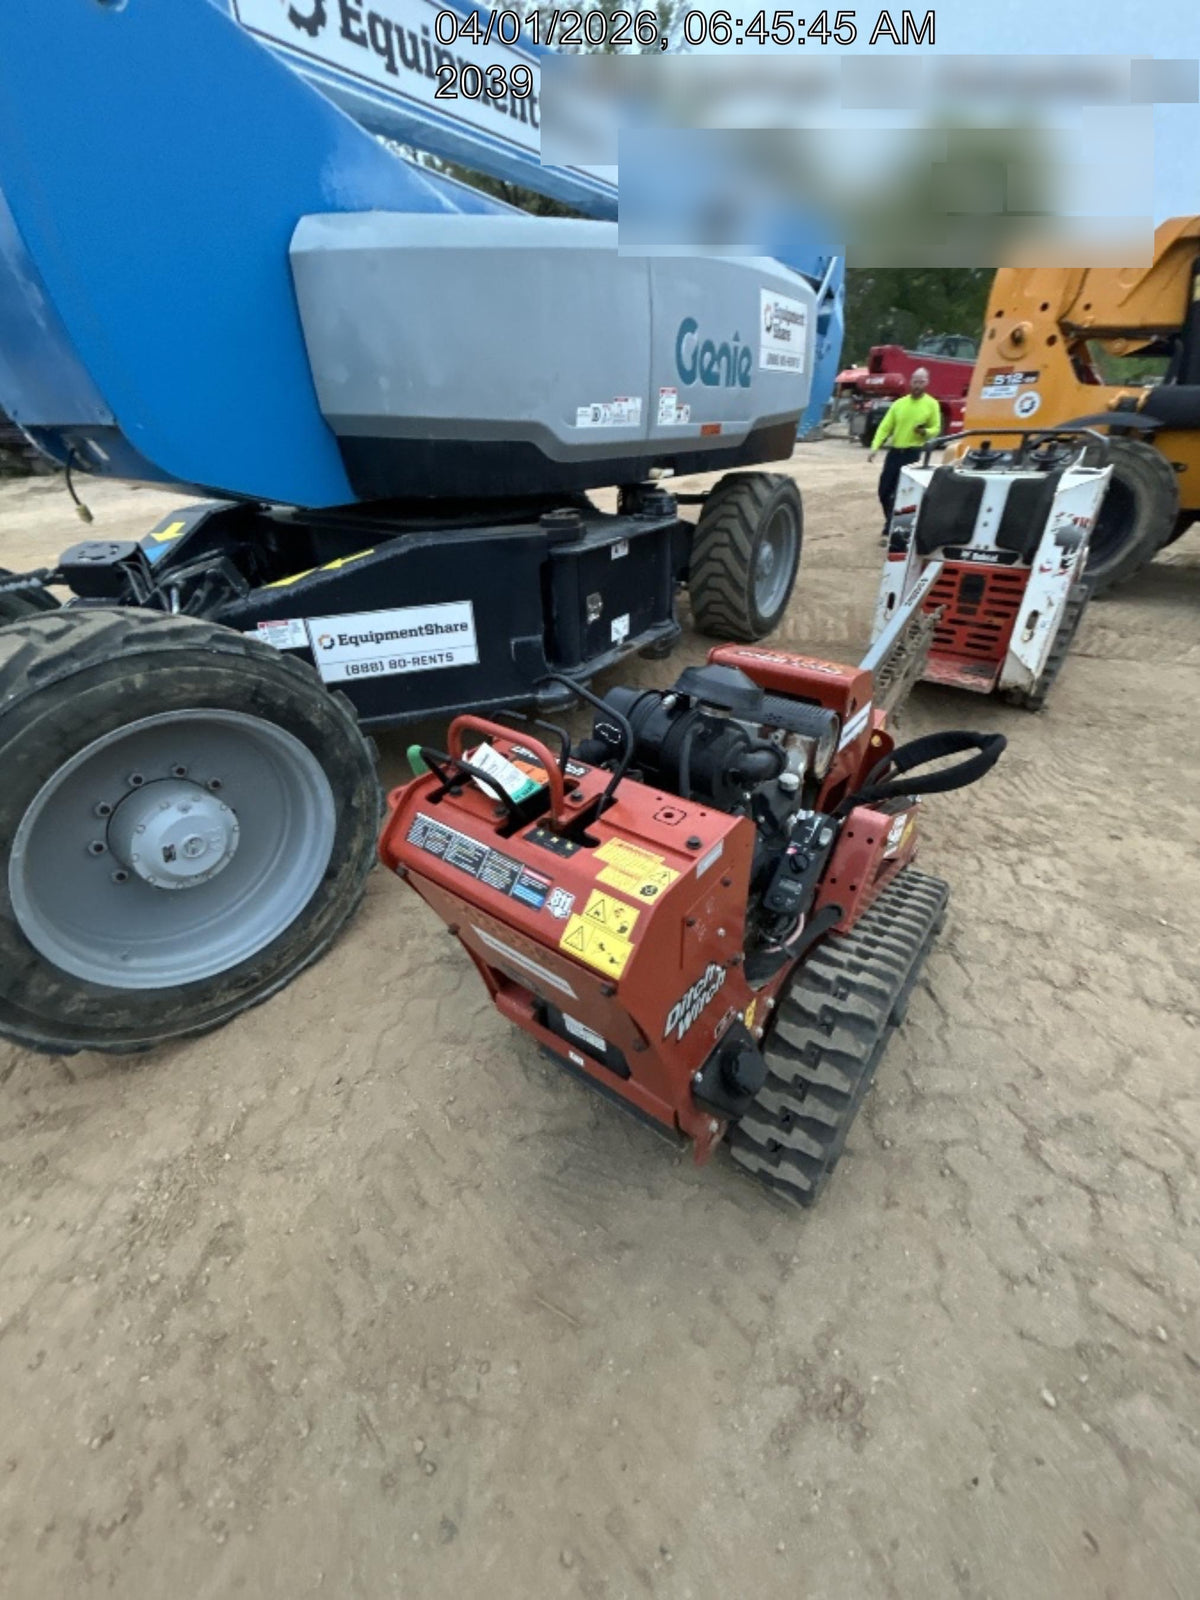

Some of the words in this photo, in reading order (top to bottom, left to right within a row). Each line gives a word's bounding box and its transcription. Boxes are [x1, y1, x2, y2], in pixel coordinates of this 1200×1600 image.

[676, 317, 752, 388] Genie
[338, 621, 469, 647] EquipmentShare
[345, 660, 385, 676] (888)
[388, 651, 454, 670] 80-RENTS
